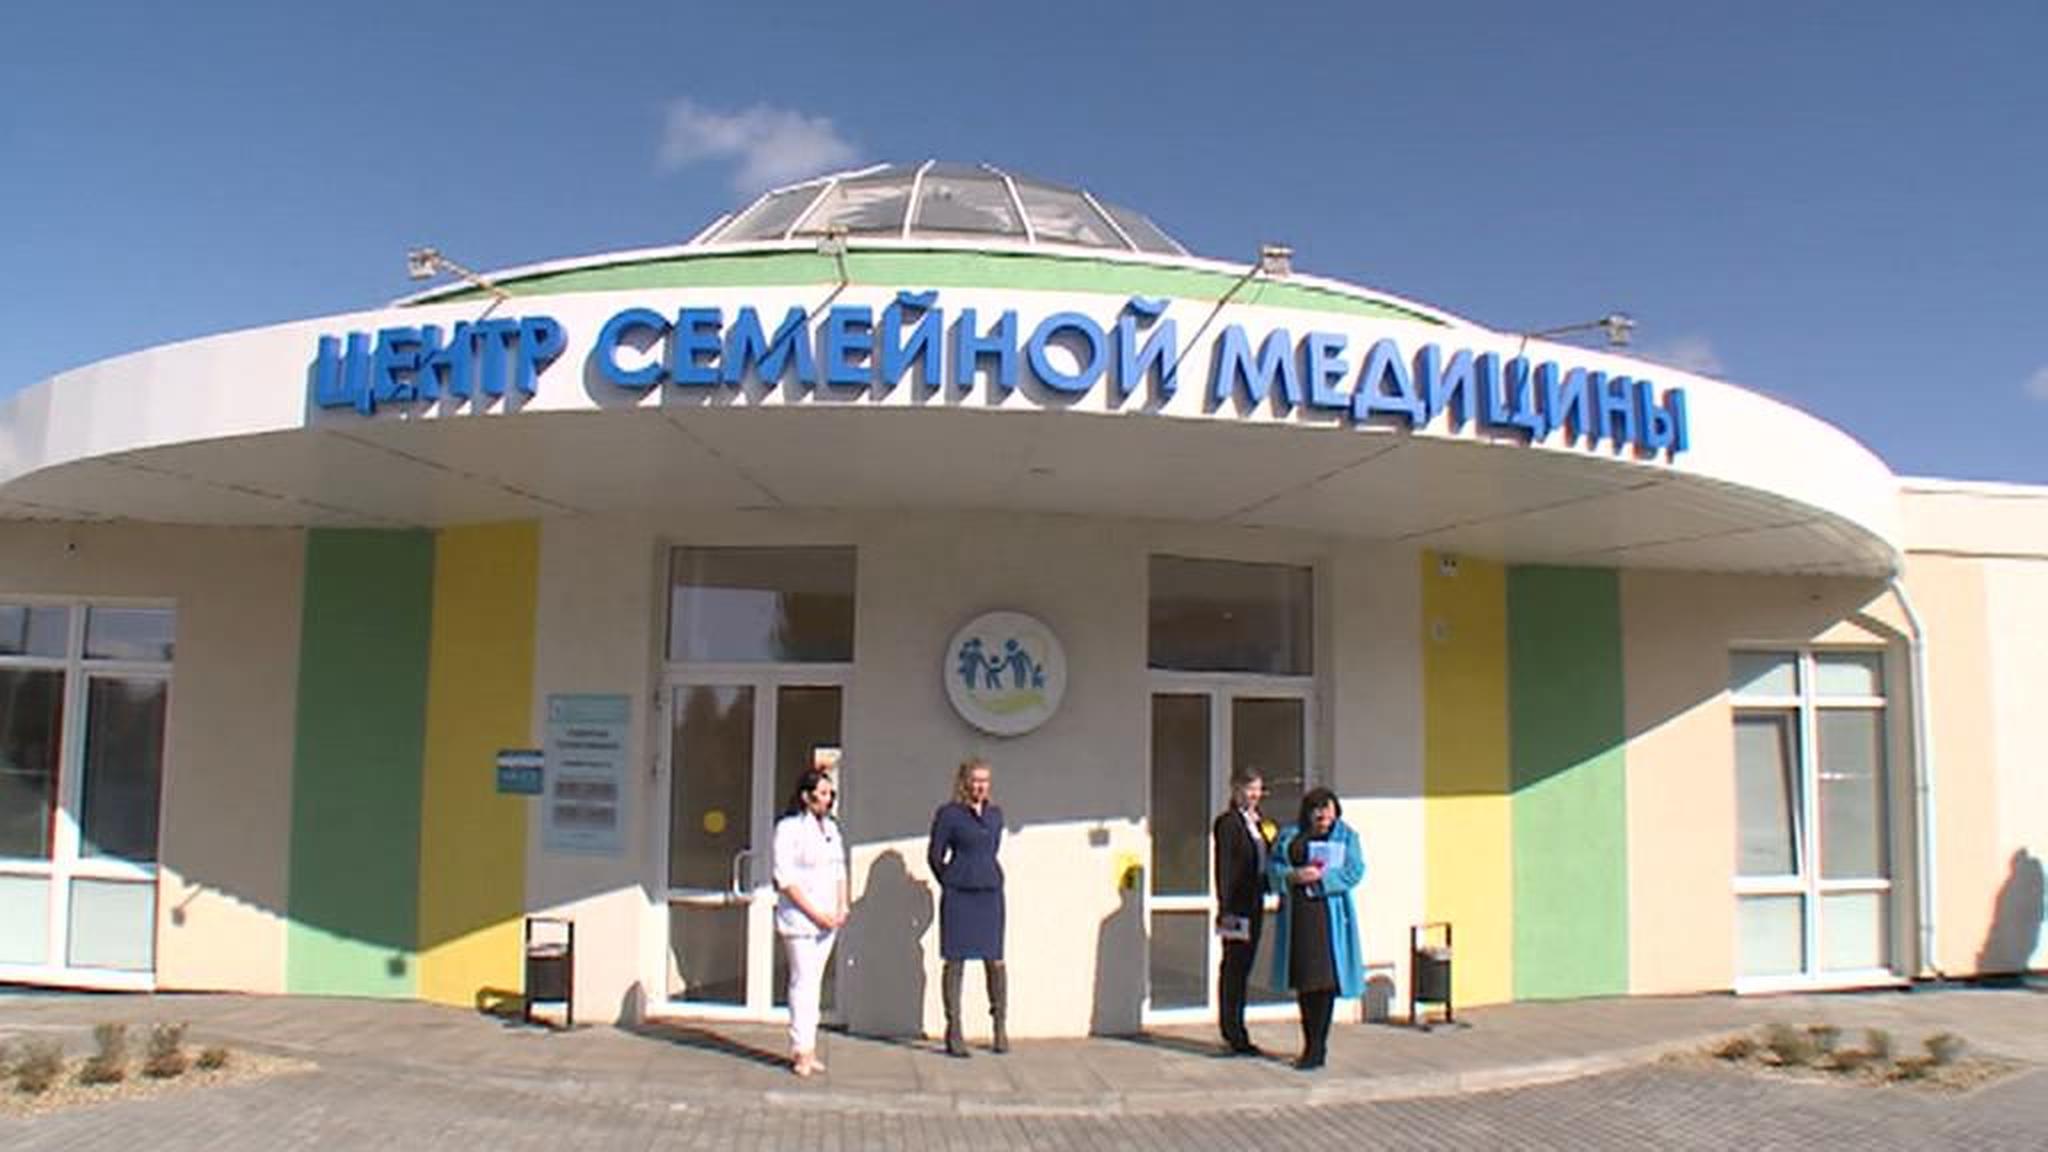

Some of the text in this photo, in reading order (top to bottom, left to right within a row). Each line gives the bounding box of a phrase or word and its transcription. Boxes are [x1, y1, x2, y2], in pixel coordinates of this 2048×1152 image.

[317, 290, 1690, 457] ЦЕНТР СЕМЕЙНОЙ МЕДИЦИНЫ
